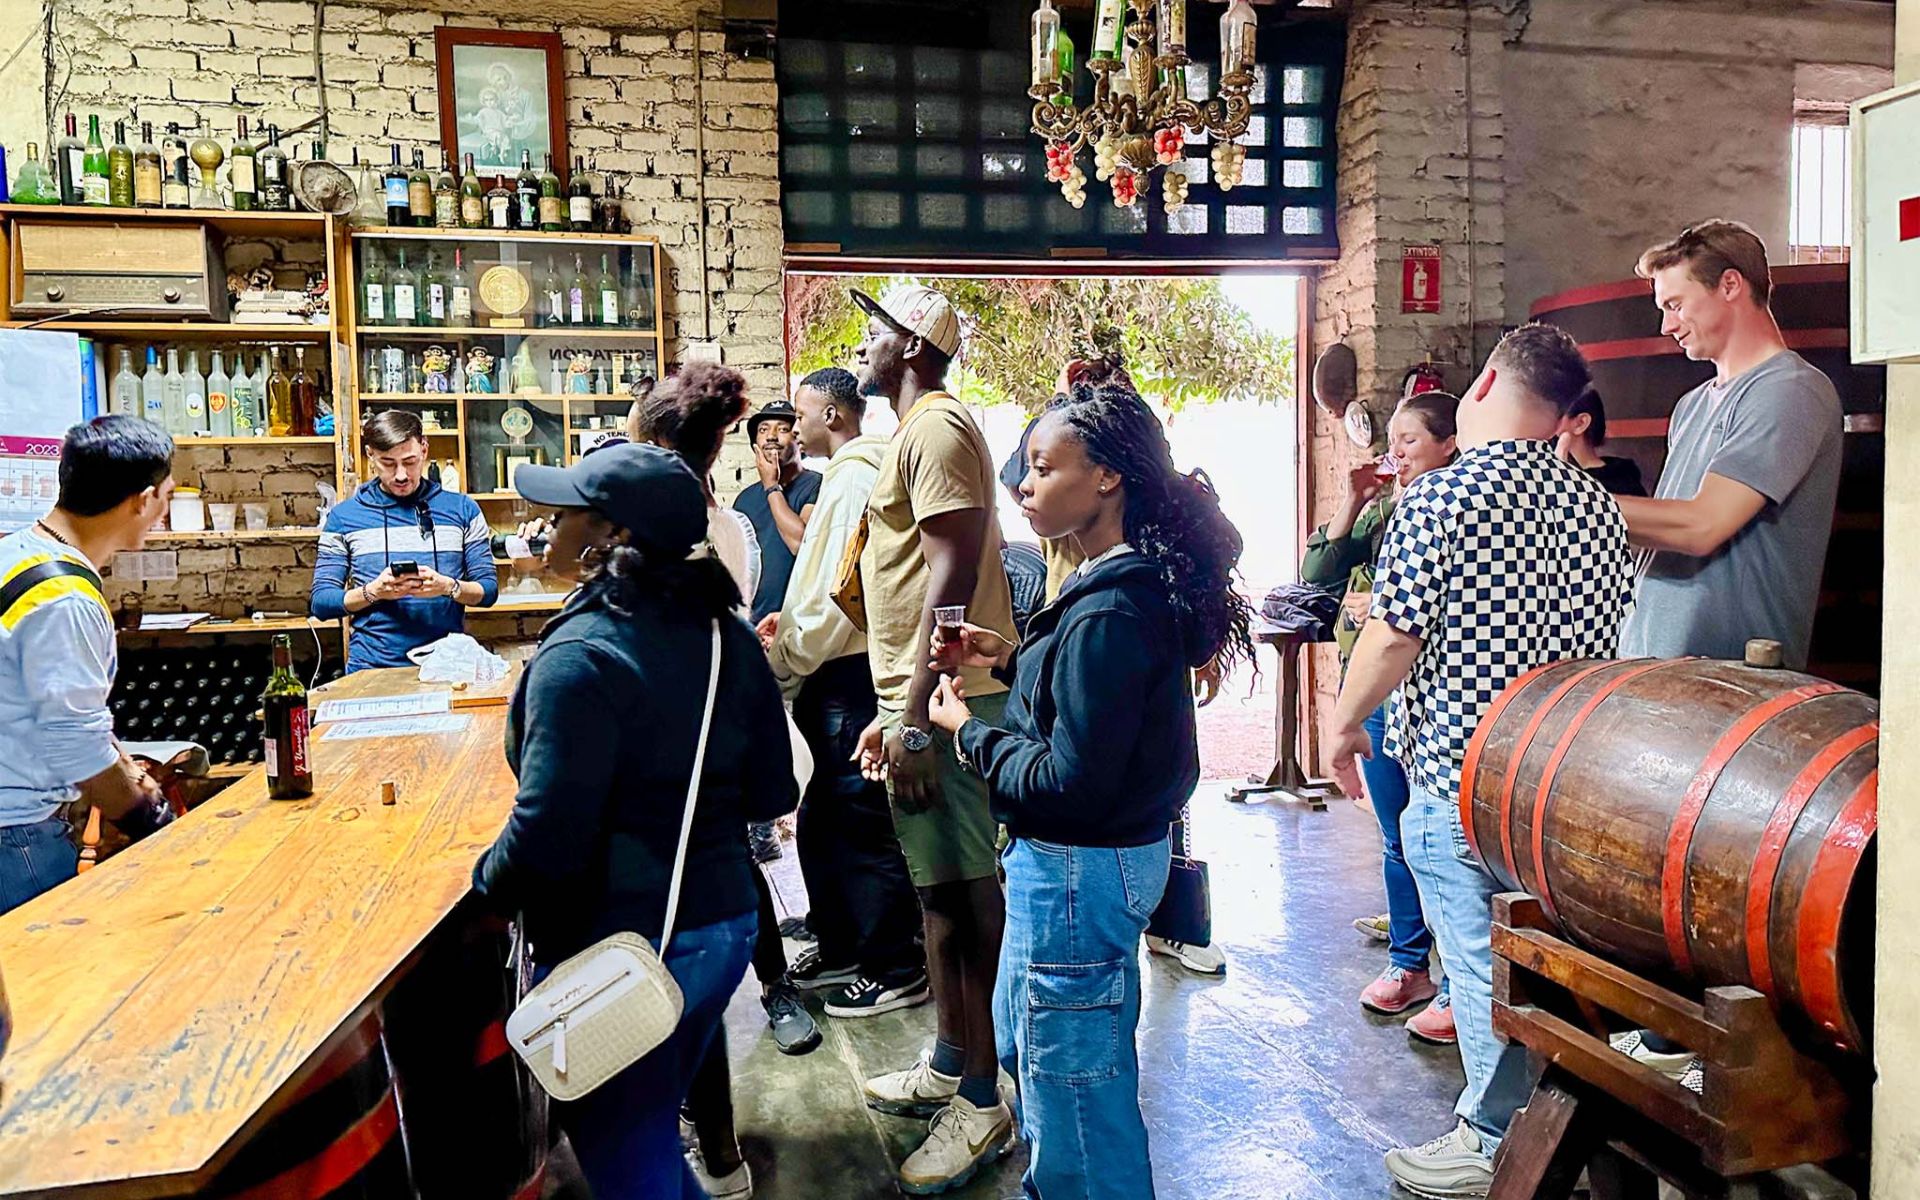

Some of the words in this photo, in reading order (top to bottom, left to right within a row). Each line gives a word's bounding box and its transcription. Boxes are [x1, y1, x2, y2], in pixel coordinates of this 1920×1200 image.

[1403, 247, 1439, 257] EXTINTOR
[593, 434, 606, 446] NO
[25, 443, 60, 456] 2023
